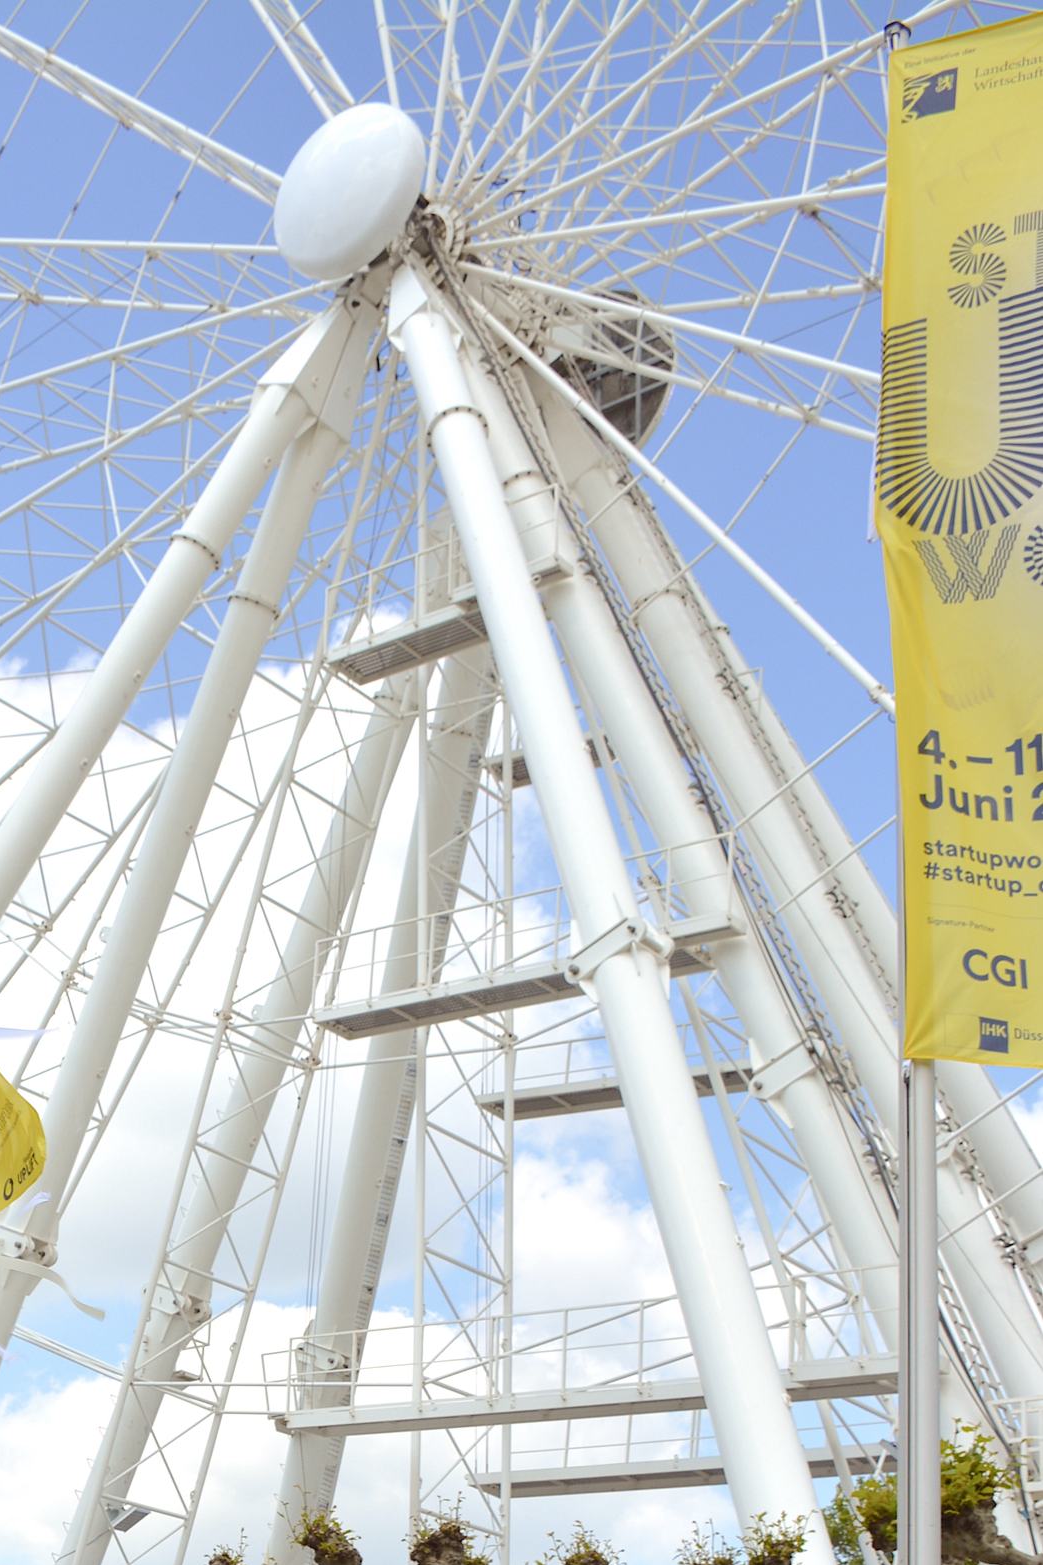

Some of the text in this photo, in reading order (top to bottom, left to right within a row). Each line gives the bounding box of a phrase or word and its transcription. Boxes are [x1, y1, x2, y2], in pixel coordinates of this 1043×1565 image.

[904, 47, 977, 69] Eine Initiative der
[918, 729, 957, 770] 4.
[919, 774, 1014, 822] Juni
[962, 948, 1028, 990] CGI
[981, 1022, 1007, 1038] IHK
[17, 1153, 38, 1184] UPLIFT
